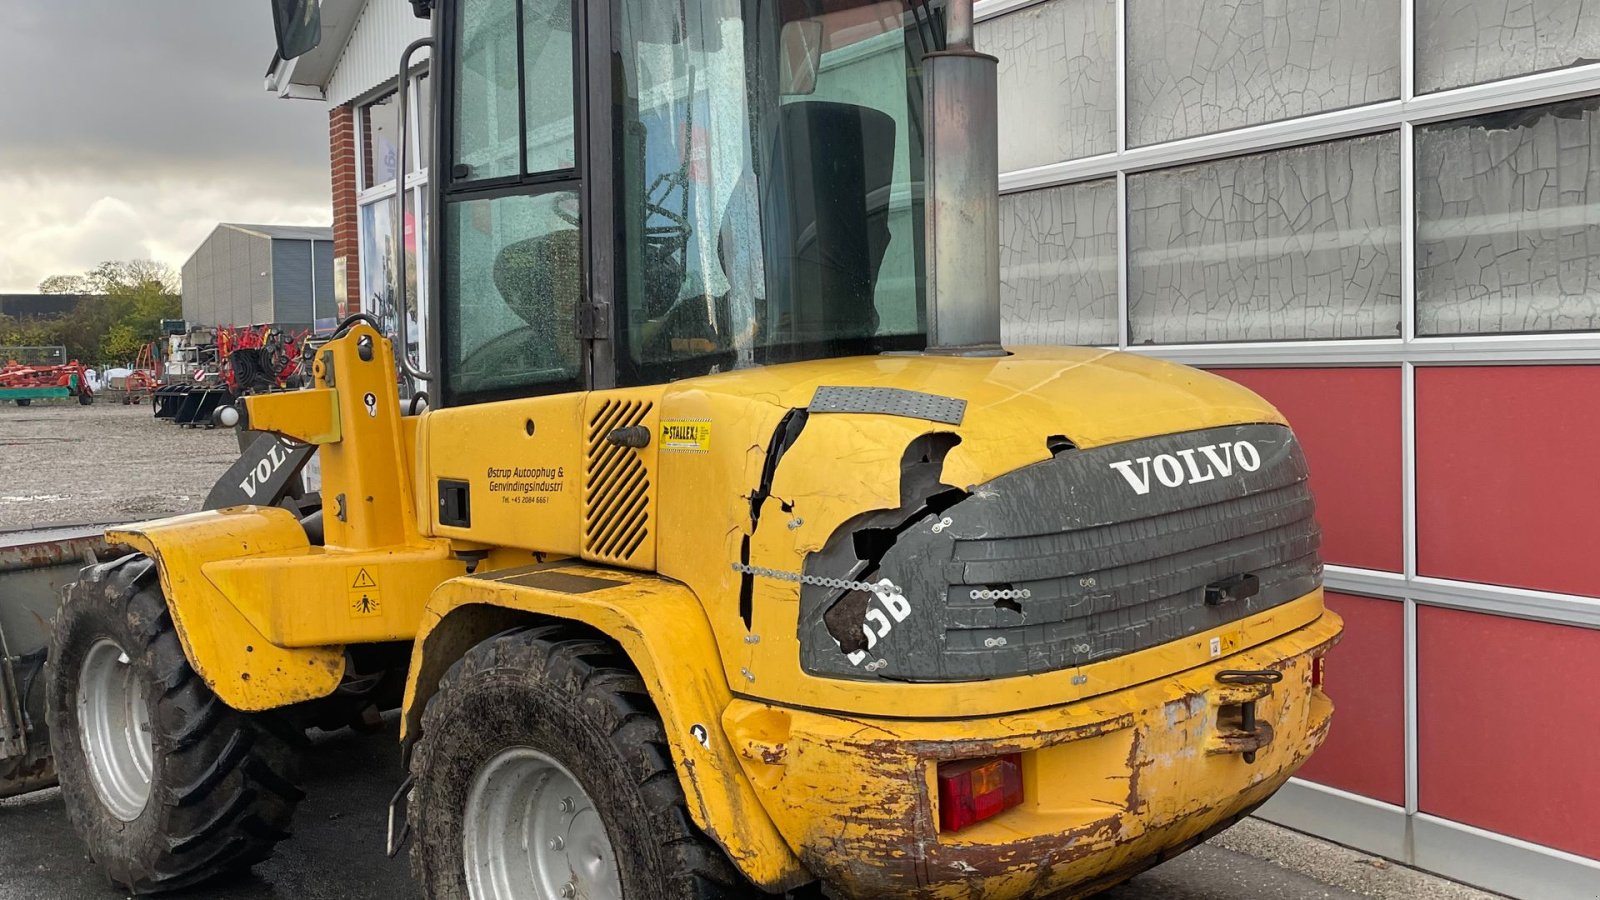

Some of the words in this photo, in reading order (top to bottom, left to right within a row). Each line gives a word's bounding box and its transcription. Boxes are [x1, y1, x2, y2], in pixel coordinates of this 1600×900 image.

[239, 437, 296, 499] VOL
[487, 467, 512, 479] Østrup
[513, 467, 556, 479] Autoophug
[558, 467, 564, 477] &
[1109, 440, 1261, 496] VOLVO
[489, 481, 563, 494] Genvindingsindustri
[511, 496, 521, 504] +45
